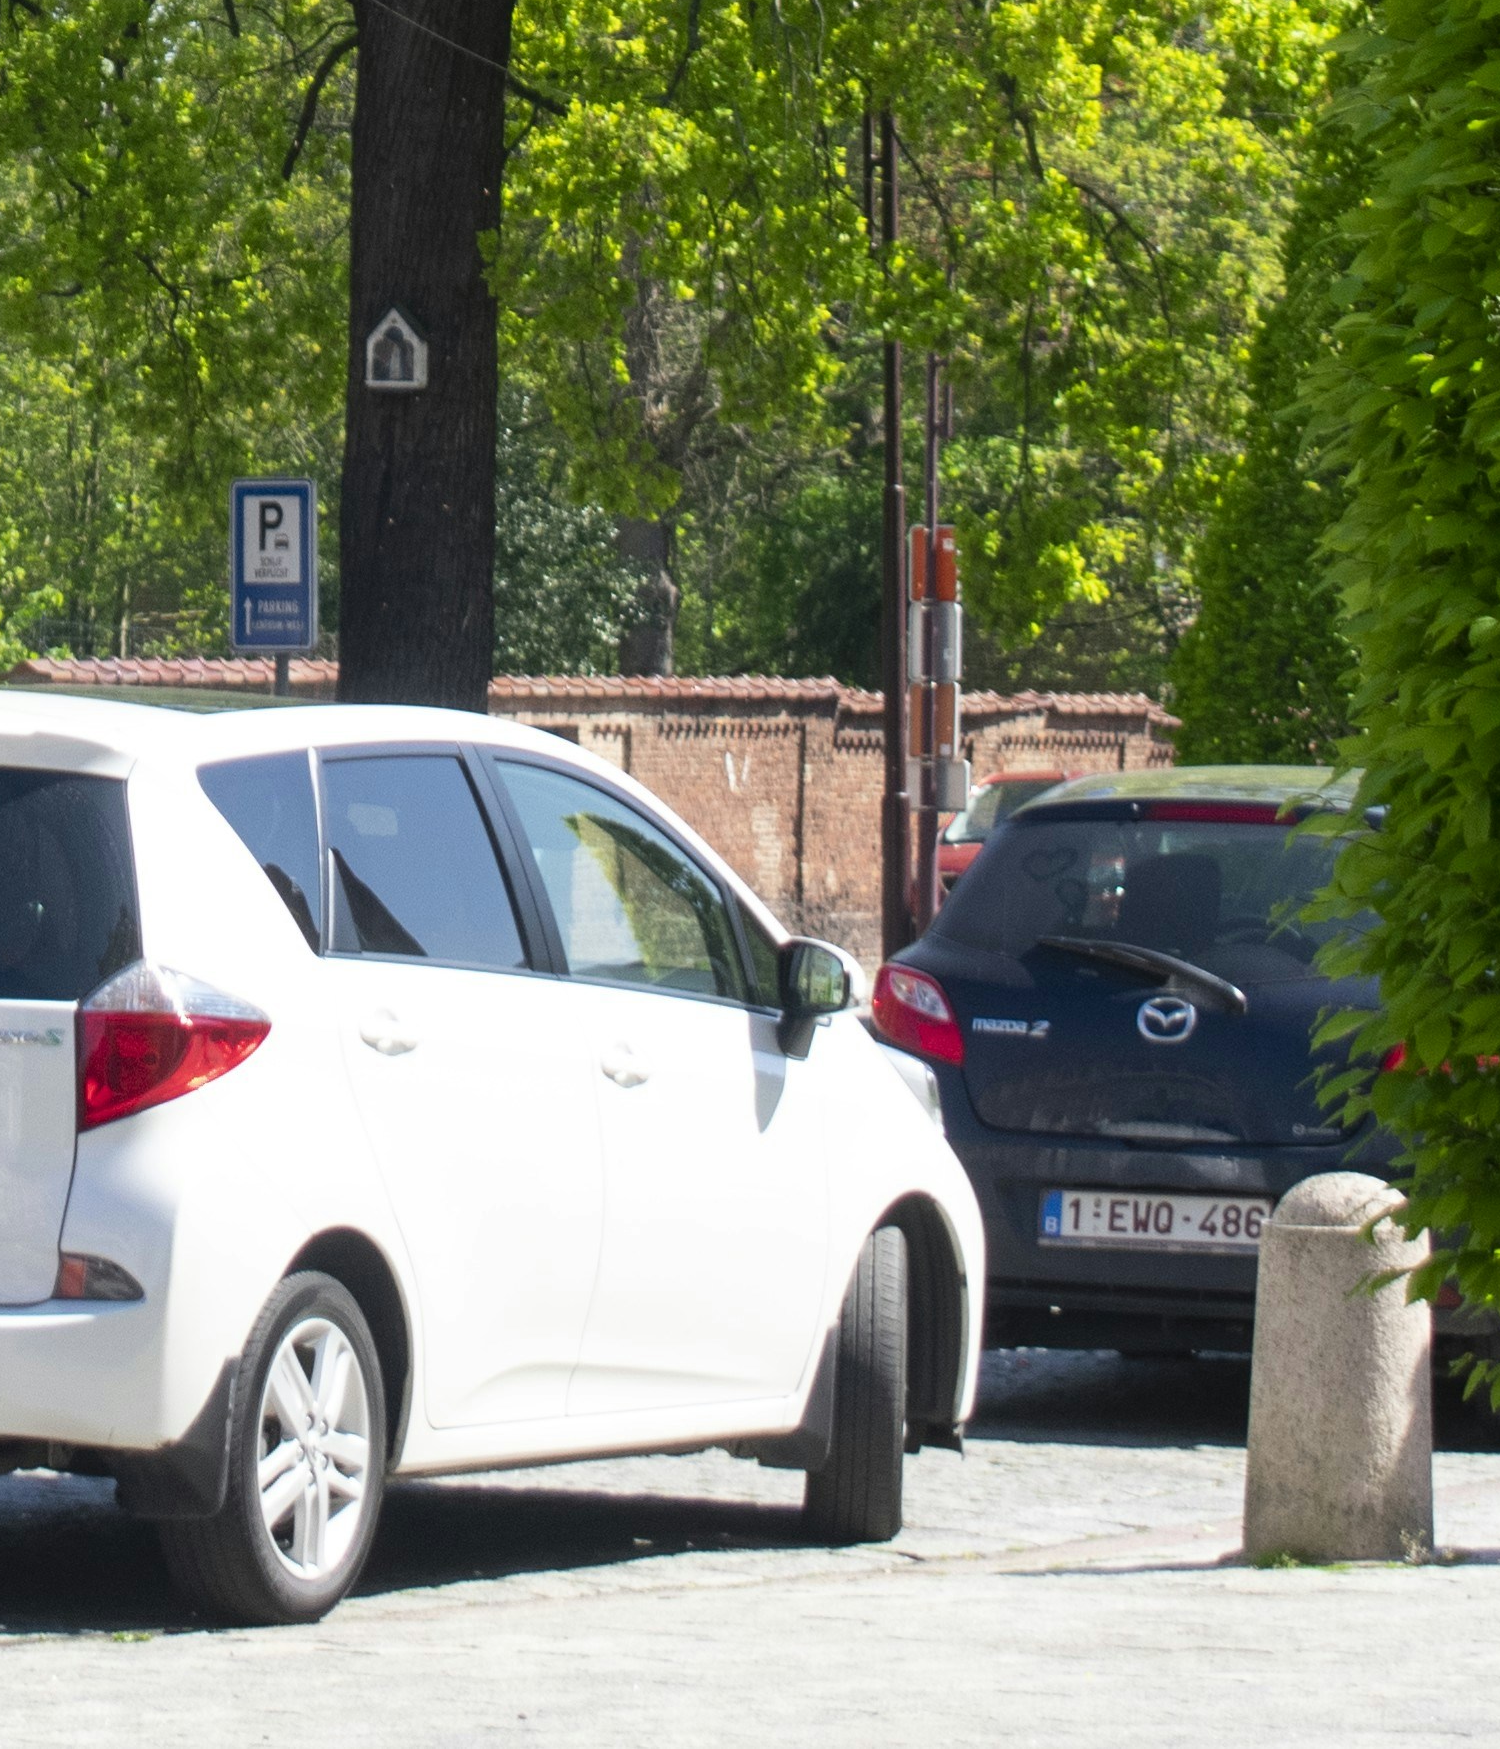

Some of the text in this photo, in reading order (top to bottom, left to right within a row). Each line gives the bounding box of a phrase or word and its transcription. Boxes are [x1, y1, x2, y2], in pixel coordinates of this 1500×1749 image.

[259, 501, 283, 551] P
[258, 600, 299, 613] PARKING
[1044, 1216, 1058, 1234] B
[1069, 1197, 1266, 1239] 1-EWQ-486
